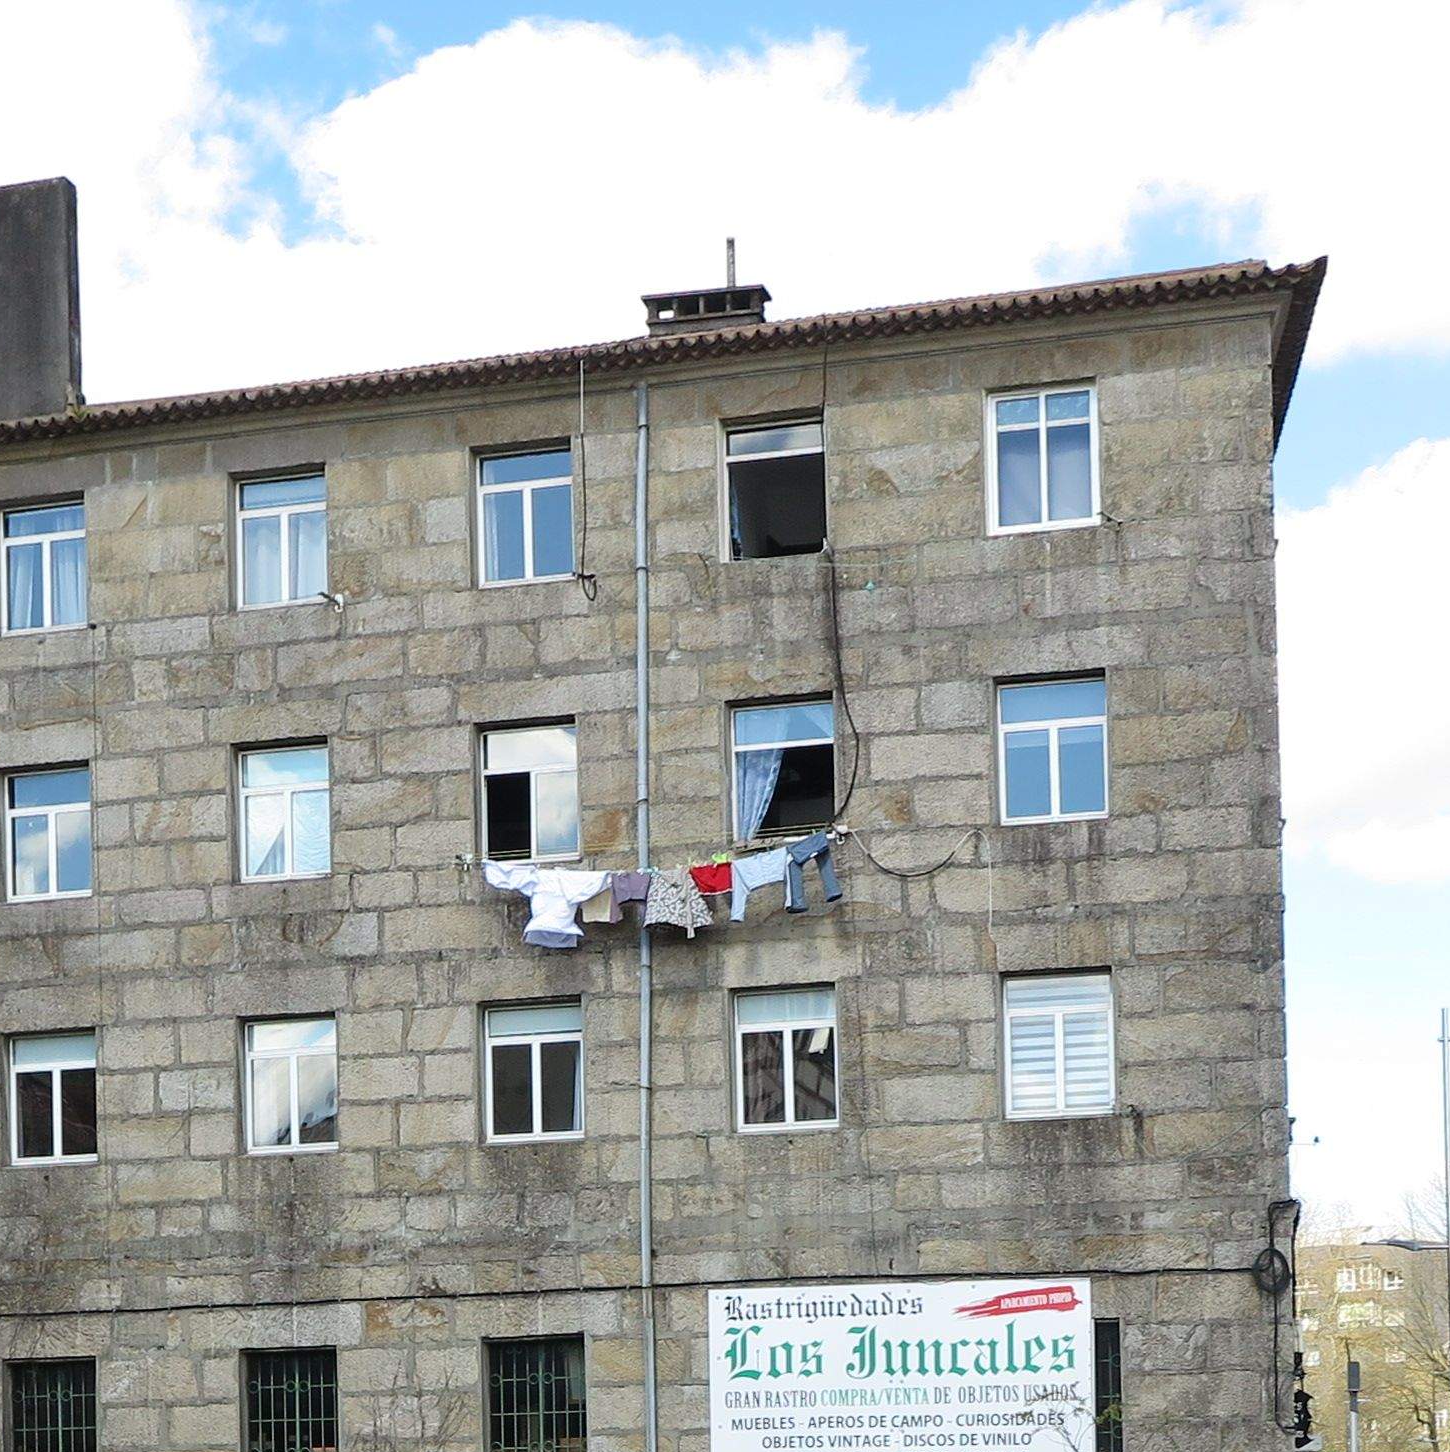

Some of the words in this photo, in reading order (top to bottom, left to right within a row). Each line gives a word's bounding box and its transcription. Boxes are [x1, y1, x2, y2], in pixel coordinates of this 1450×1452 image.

[724, 1292, 923, 1323] Rastrigüedades
[724, 1325, 824, 1382] Los
[846, 1319, 1076, 1380] Juncales
[724, 1391, 761, 1409] GRAN
[764, 1390, 818, 1409] RASTRO
[820, 1387, 929, 1407] COMPRA/VENTA
[934, 1386, 951, 1404] DE
[958, 1385, 1020, 1404] OBJETOS
[1023, 1383, 1078, 1403] USADOS
[731, 1417, 796, 1431] MUEBLES
[807, 1415, 865, 1429] APEROS
[868, 1415, 888, 1428] DE
[891, 1414, 944, 1428] CAMPO
[955, 1412, 1066, 1427] CURIOSIDADES
[762, 1435, 825, 1449] OBJETOS
[827, 1434, 891, 1448] VINTAGE
[903, 1433, 956, 1447] DISCOS
[959, 1433, 979, 1446] DE
[982, 1432, 1032, 1446] VINILO
